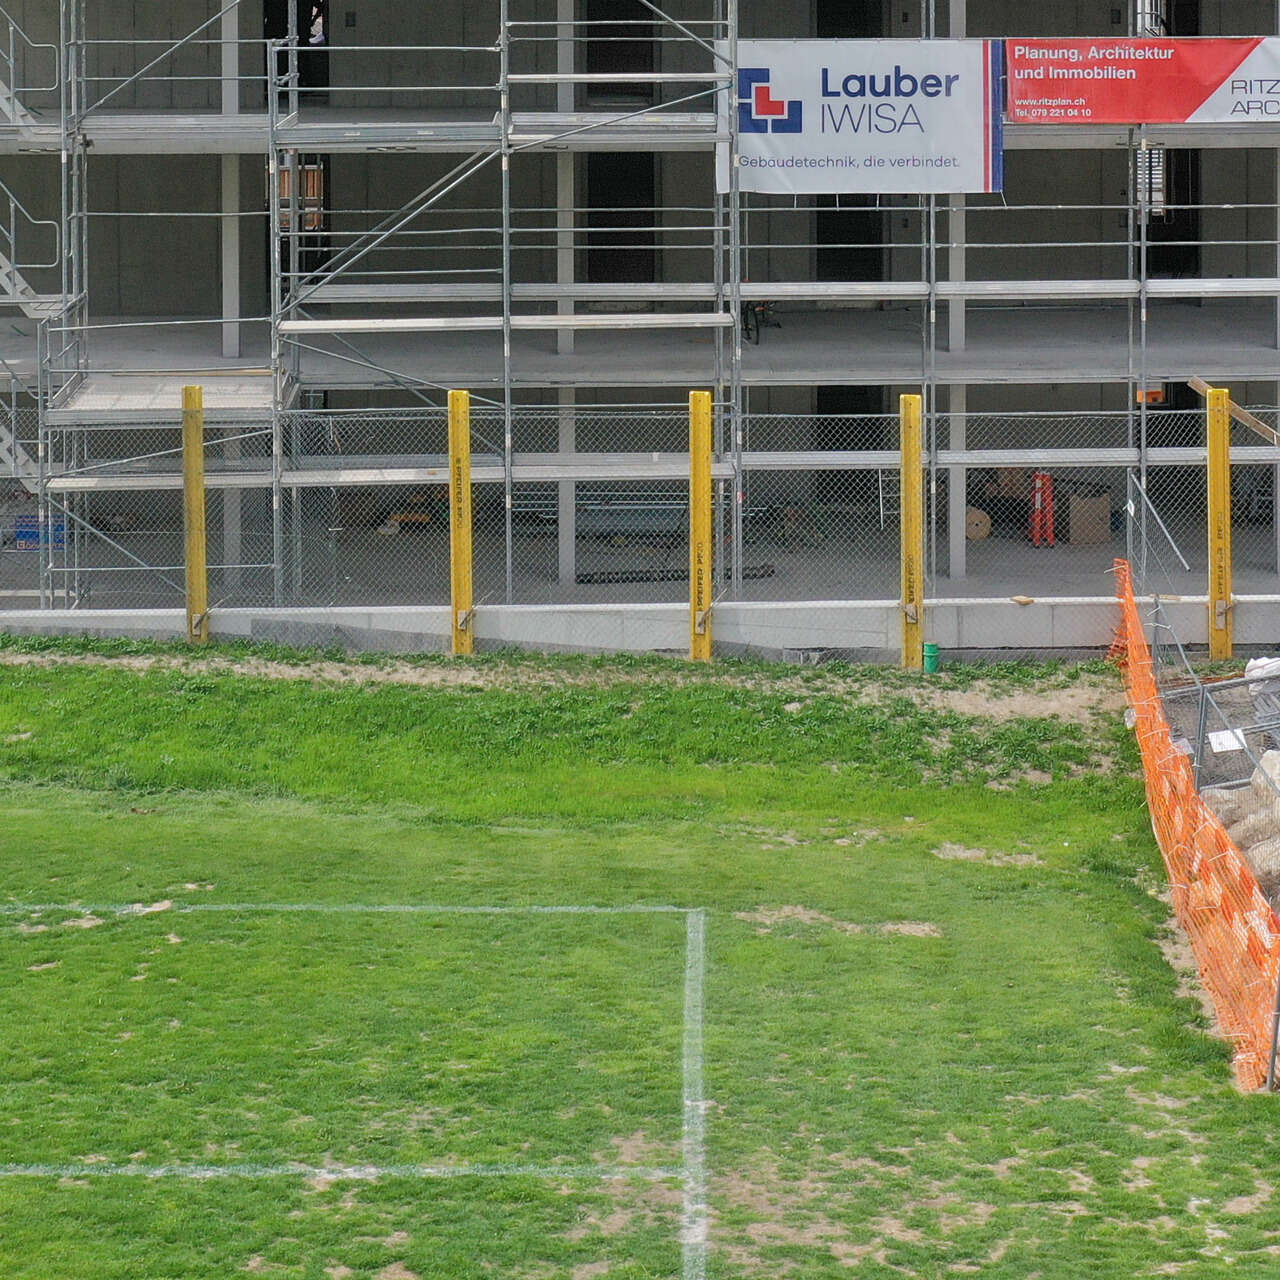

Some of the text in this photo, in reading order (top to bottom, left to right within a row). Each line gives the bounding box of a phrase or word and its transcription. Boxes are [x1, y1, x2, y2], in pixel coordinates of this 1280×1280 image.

[1014, 46, 1174, 61] Planung, Architektur
[1014, 66, 1136, 79] und Immobilien
[821, 65, 960, 97] Lauber
[1231, 79, 1280, 95] RITZ
[1015, 98, 1086, 107] www.ritzplan.ch
[821, 103, 925, 133] IWISA
[1015, 109, 1092, 117] Tel. 079 221 04 10
[863, 155, 885, 168] die
[890, 155, 960, 168] verbindet.
